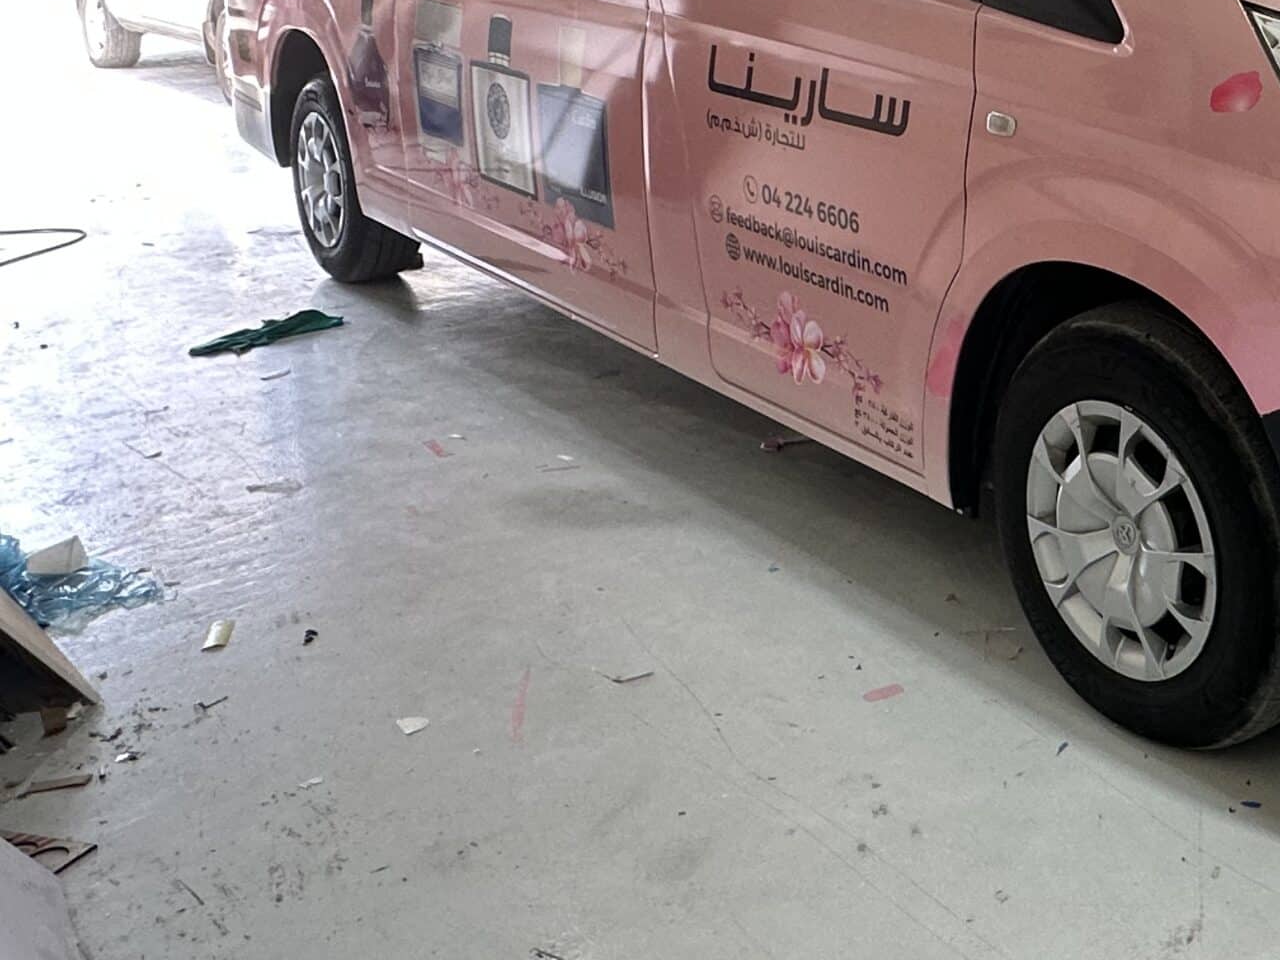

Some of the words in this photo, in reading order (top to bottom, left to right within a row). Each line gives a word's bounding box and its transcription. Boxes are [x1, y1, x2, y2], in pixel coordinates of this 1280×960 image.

[708, 44, 911, 137] سارينا
[764, 123, 806, 151] للتجارة
[762, 184, 781, 208] 04
[785, 191, 814, 219] 224
[817, 201, 860, 234] 6606
[726, 207, 907, 286] feedback@louiscardin.com
[742, 246, 889, 313] www.louiscardin.com
